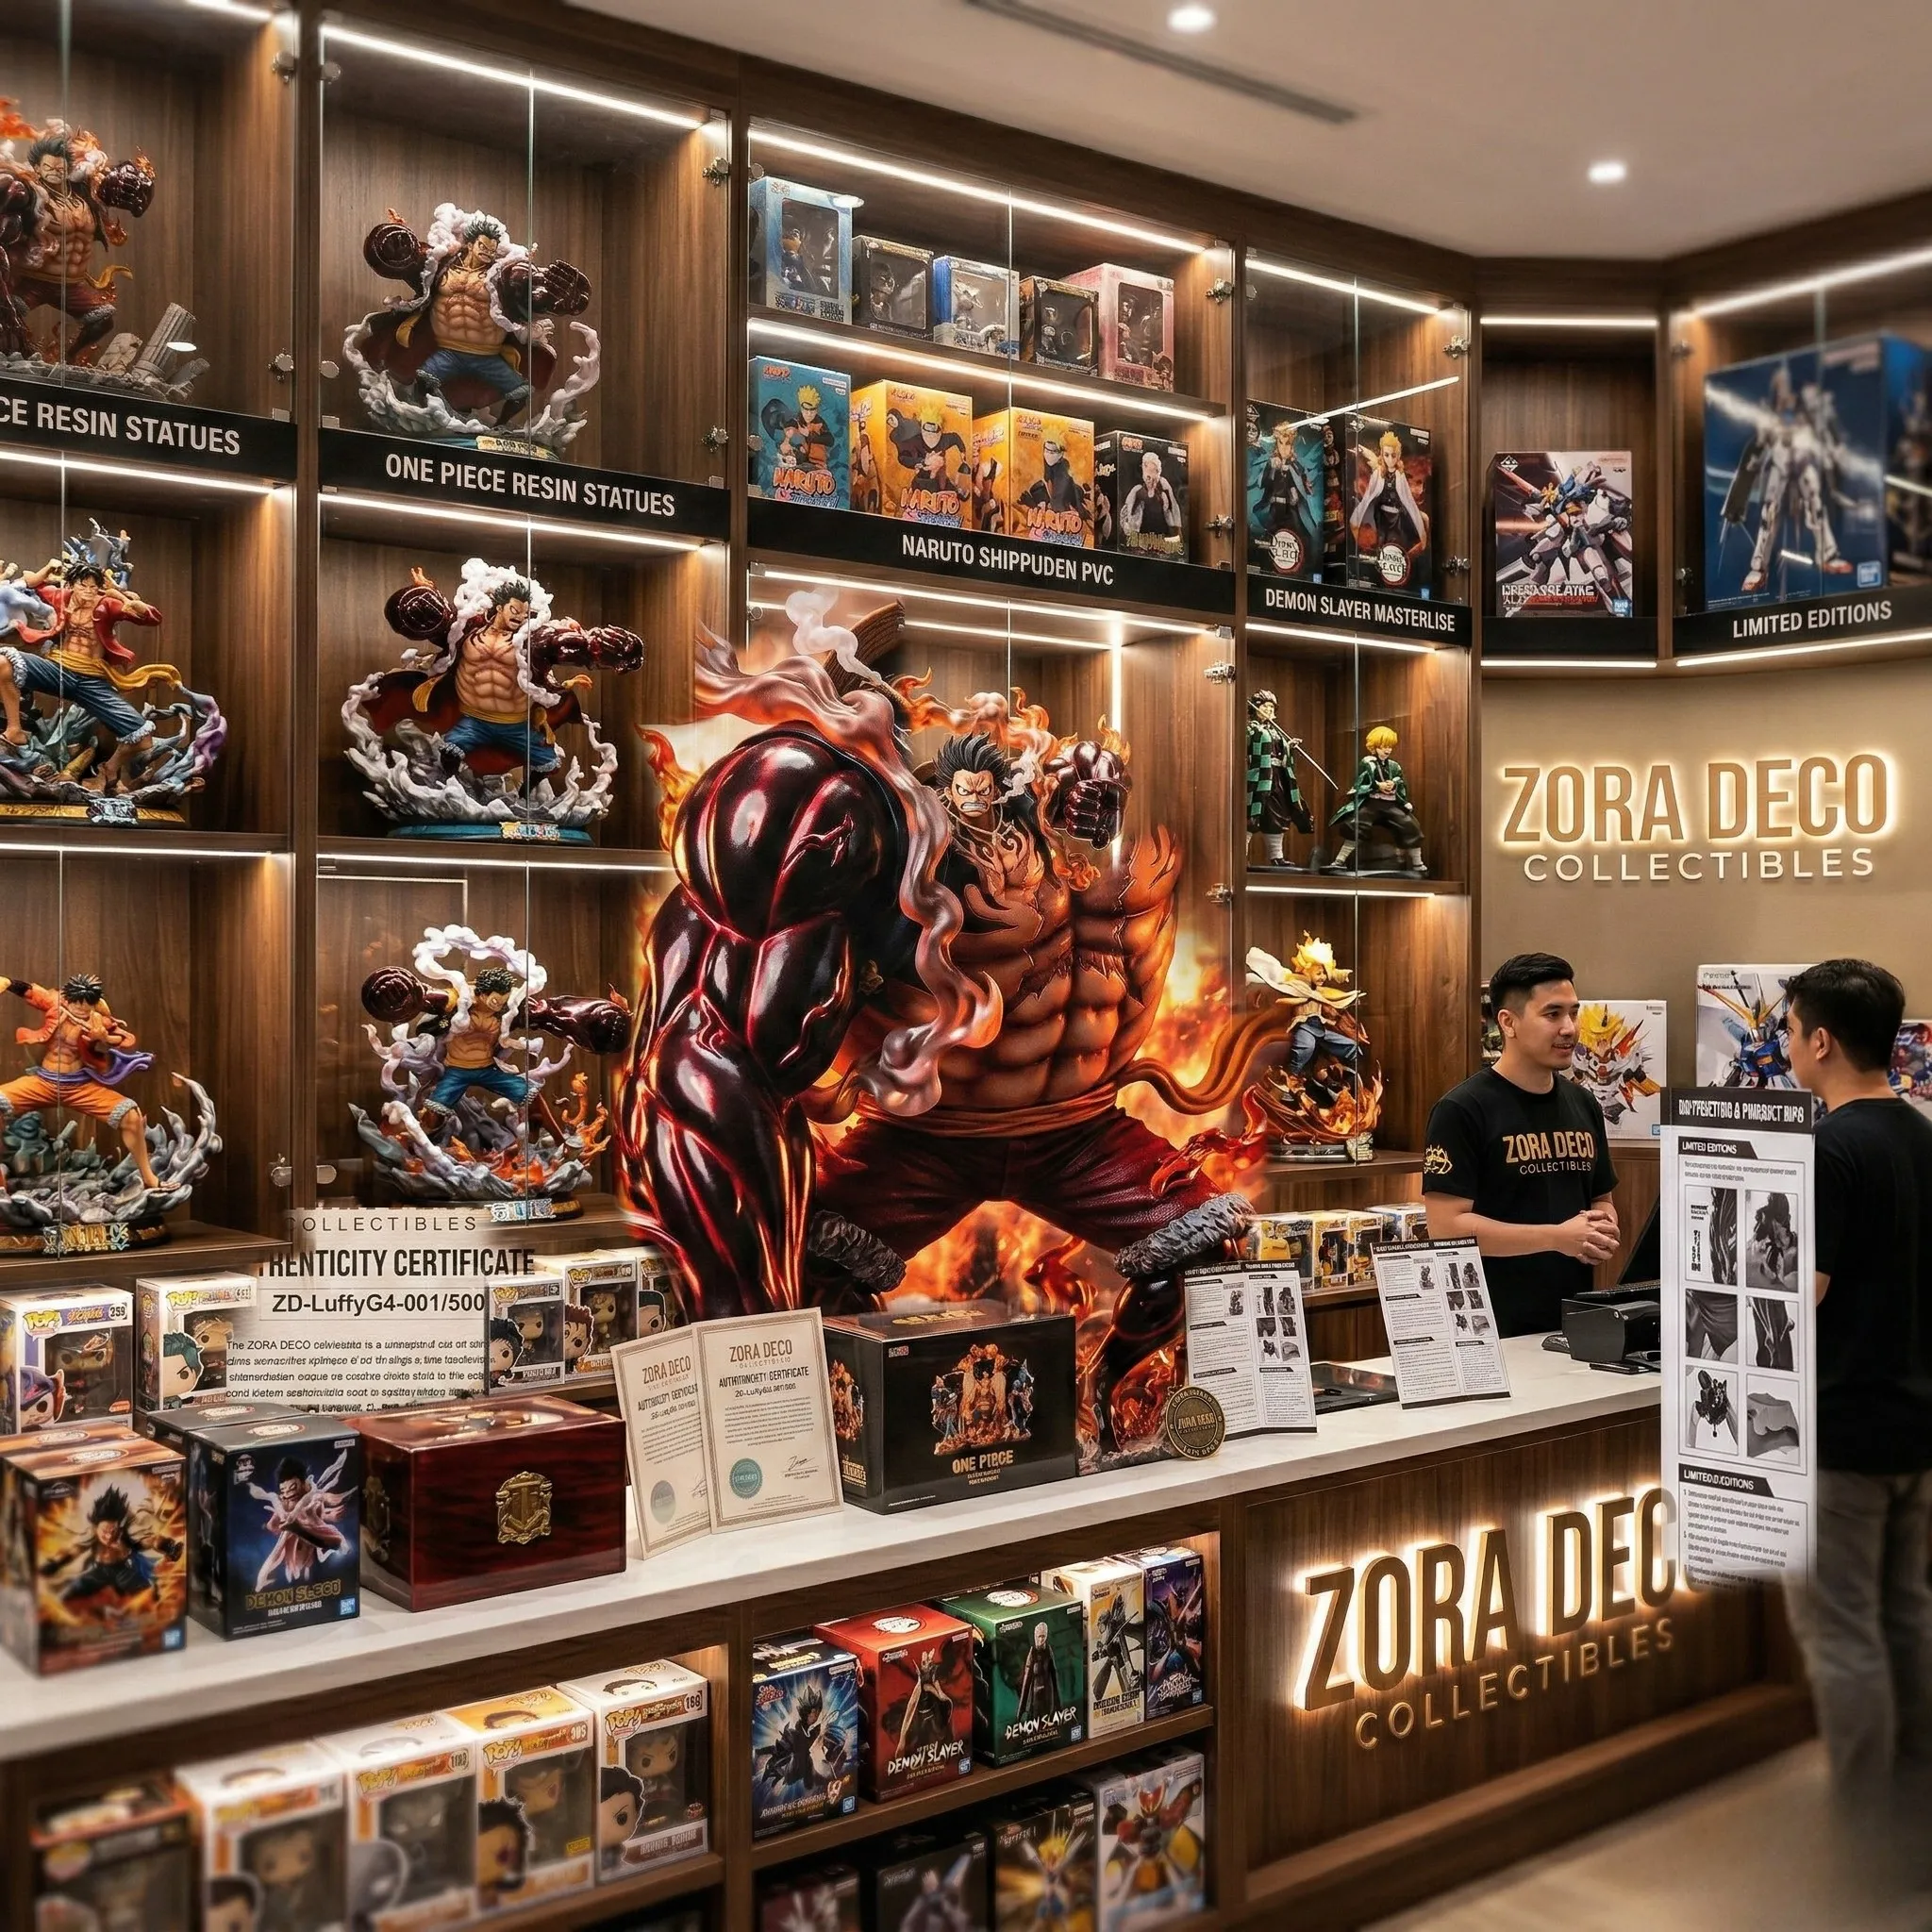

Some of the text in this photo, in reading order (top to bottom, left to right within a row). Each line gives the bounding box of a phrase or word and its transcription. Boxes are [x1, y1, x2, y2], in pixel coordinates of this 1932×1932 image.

[37, 402, 117, 438] RESIN
[125, 415, 241, 455] STATUES
[385, 453, 675, 517] ONE PIECE RESIN STATUES
[902, 534, 1114, 586] NARUTO SHIPPUDEN PVC
[1265, 588, 1456, 632] DEMON SLAYER MASTERLISE
[1733, 600, 1892, 639] LIMITED EDITIONS
[1503, 754, 1888, 843] ZORA DECO
[1524, 848, 1874, 882] COLLECTIBLES
[1502, 1131, 1594, 1163] ZORA DECO
[1519, 1161, 1591, 1175] COLLECTIBLES
[393, 1248, 536, 1276] CERTIFICATE
[272, 1292, 485, 1317] ZD-LuffyG4-001/500
[226, 1341, 244, 1350] The
[247, 1341, 277, 1350] ZORA
[280, 1341, 311, 1350] DECO
[729, 1342, 760, 1362] ZORA
[763, 1339, 793, 1358] DECO
[642, 1361, 668, 1384] ZORA
[668, 1355, 691, 1380] DECO
[952, 1456, 976, 1474] ONE
[1294, 1527, 1520, 1712] ZORA
[1544, 1487, 1689, 1638] DEC
[1355, 1617, 1674, 1751] COLLECTIBLES
